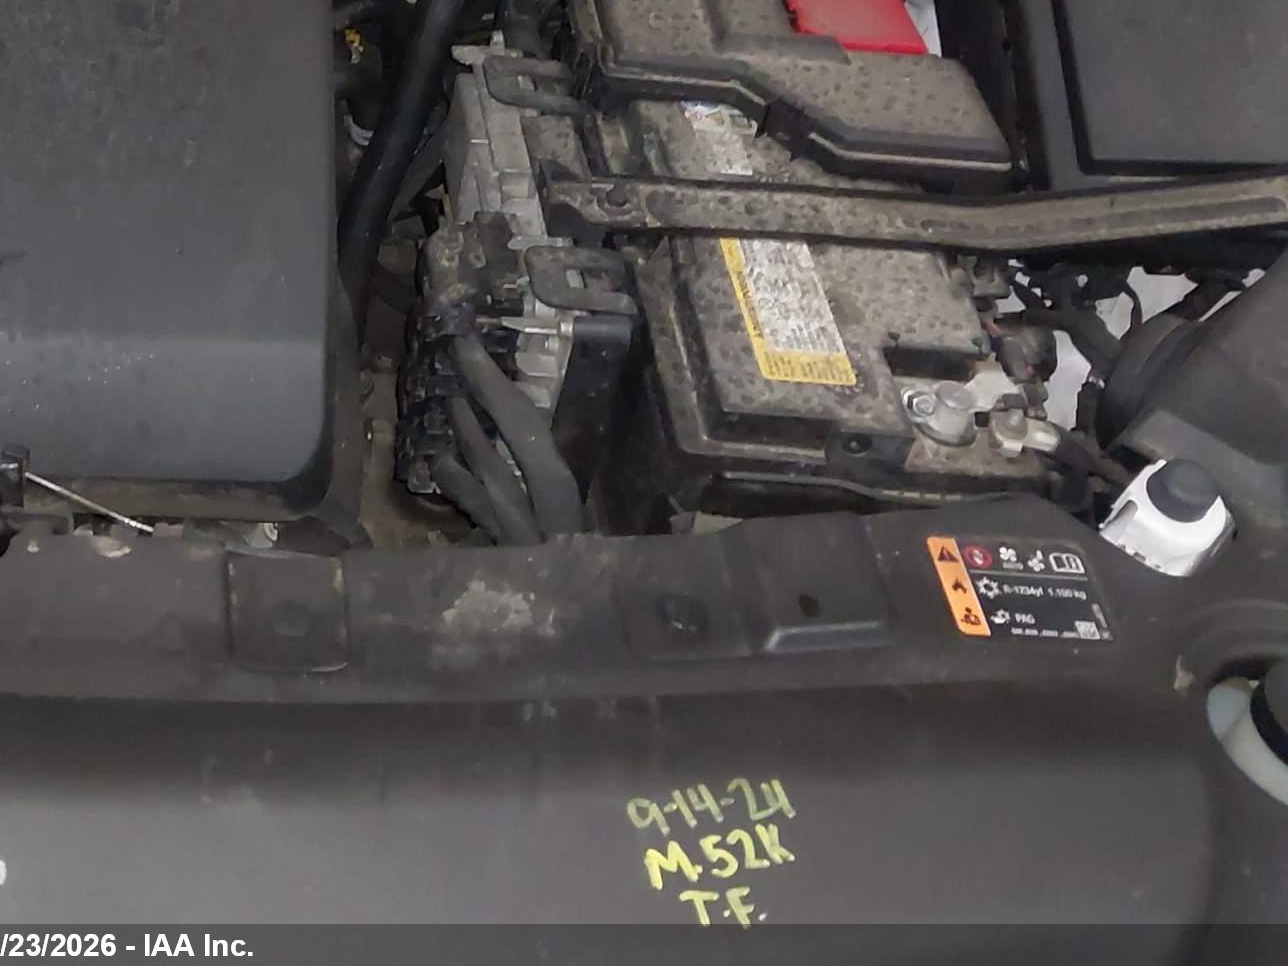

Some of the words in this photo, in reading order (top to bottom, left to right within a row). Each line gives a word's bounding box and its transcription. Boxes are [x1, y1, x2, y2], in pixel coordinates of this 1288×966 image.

[1014, 612, 1035, 624] PAG
[626, 777, 797, 837] 9-14-24
[678, 886, 768, 928] T.F.
